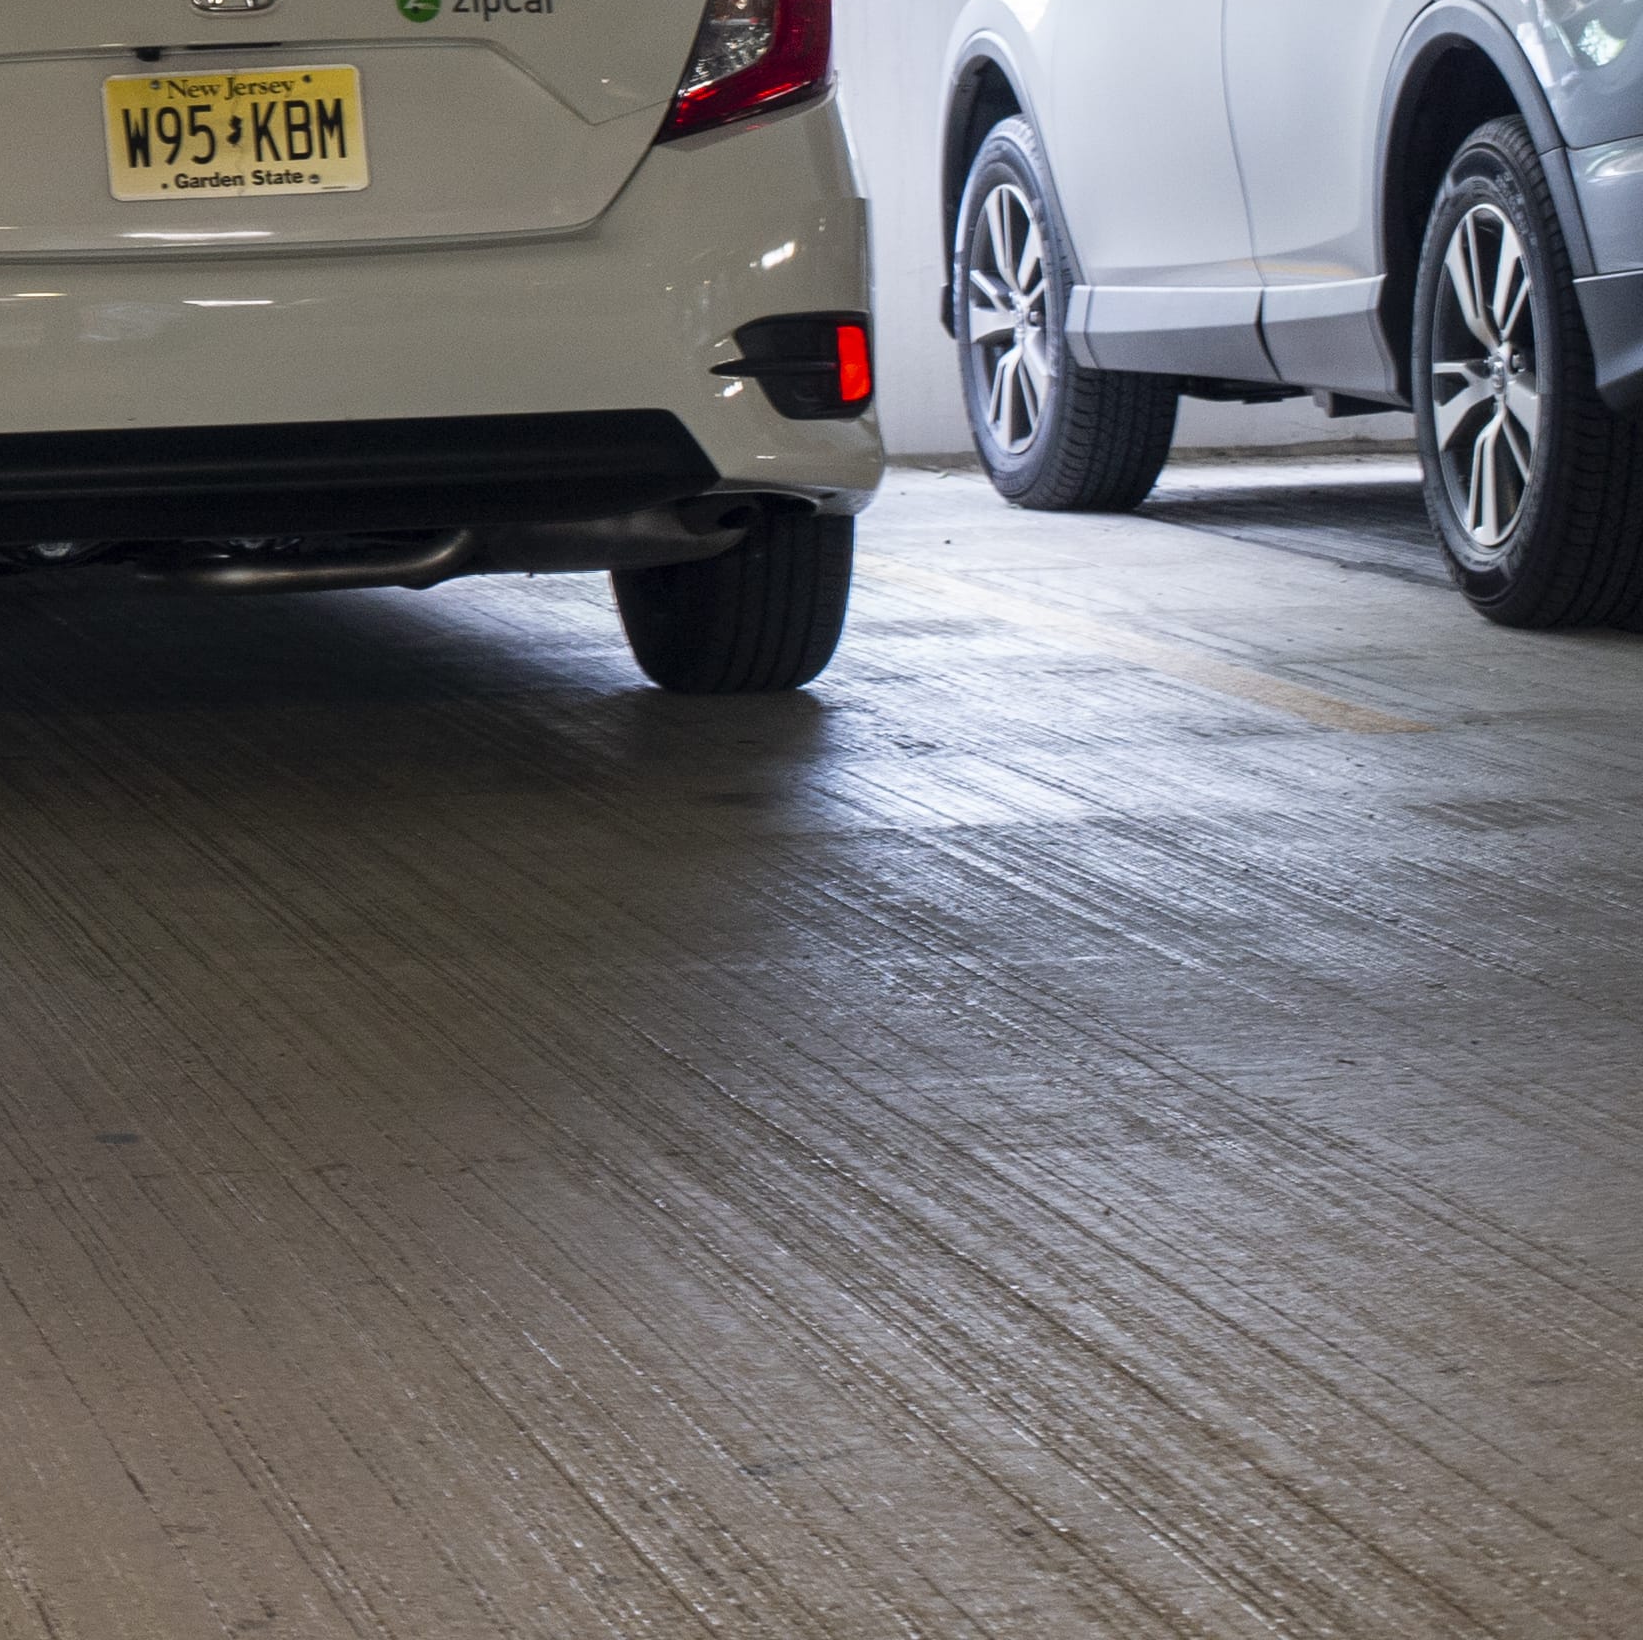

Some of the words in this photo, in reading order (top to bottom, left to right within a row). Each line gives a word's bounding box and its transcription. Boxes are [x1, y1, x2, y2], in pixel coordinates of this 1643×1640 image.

[167, 79, 220, 99] New
[224, 76, 295, 101] Jersey
[121, 104, 217, 169] W95
[250, 98, 348, 162] KBM
[174, 171, 245, 190] Garden
[251, 169, 304, 186] State
